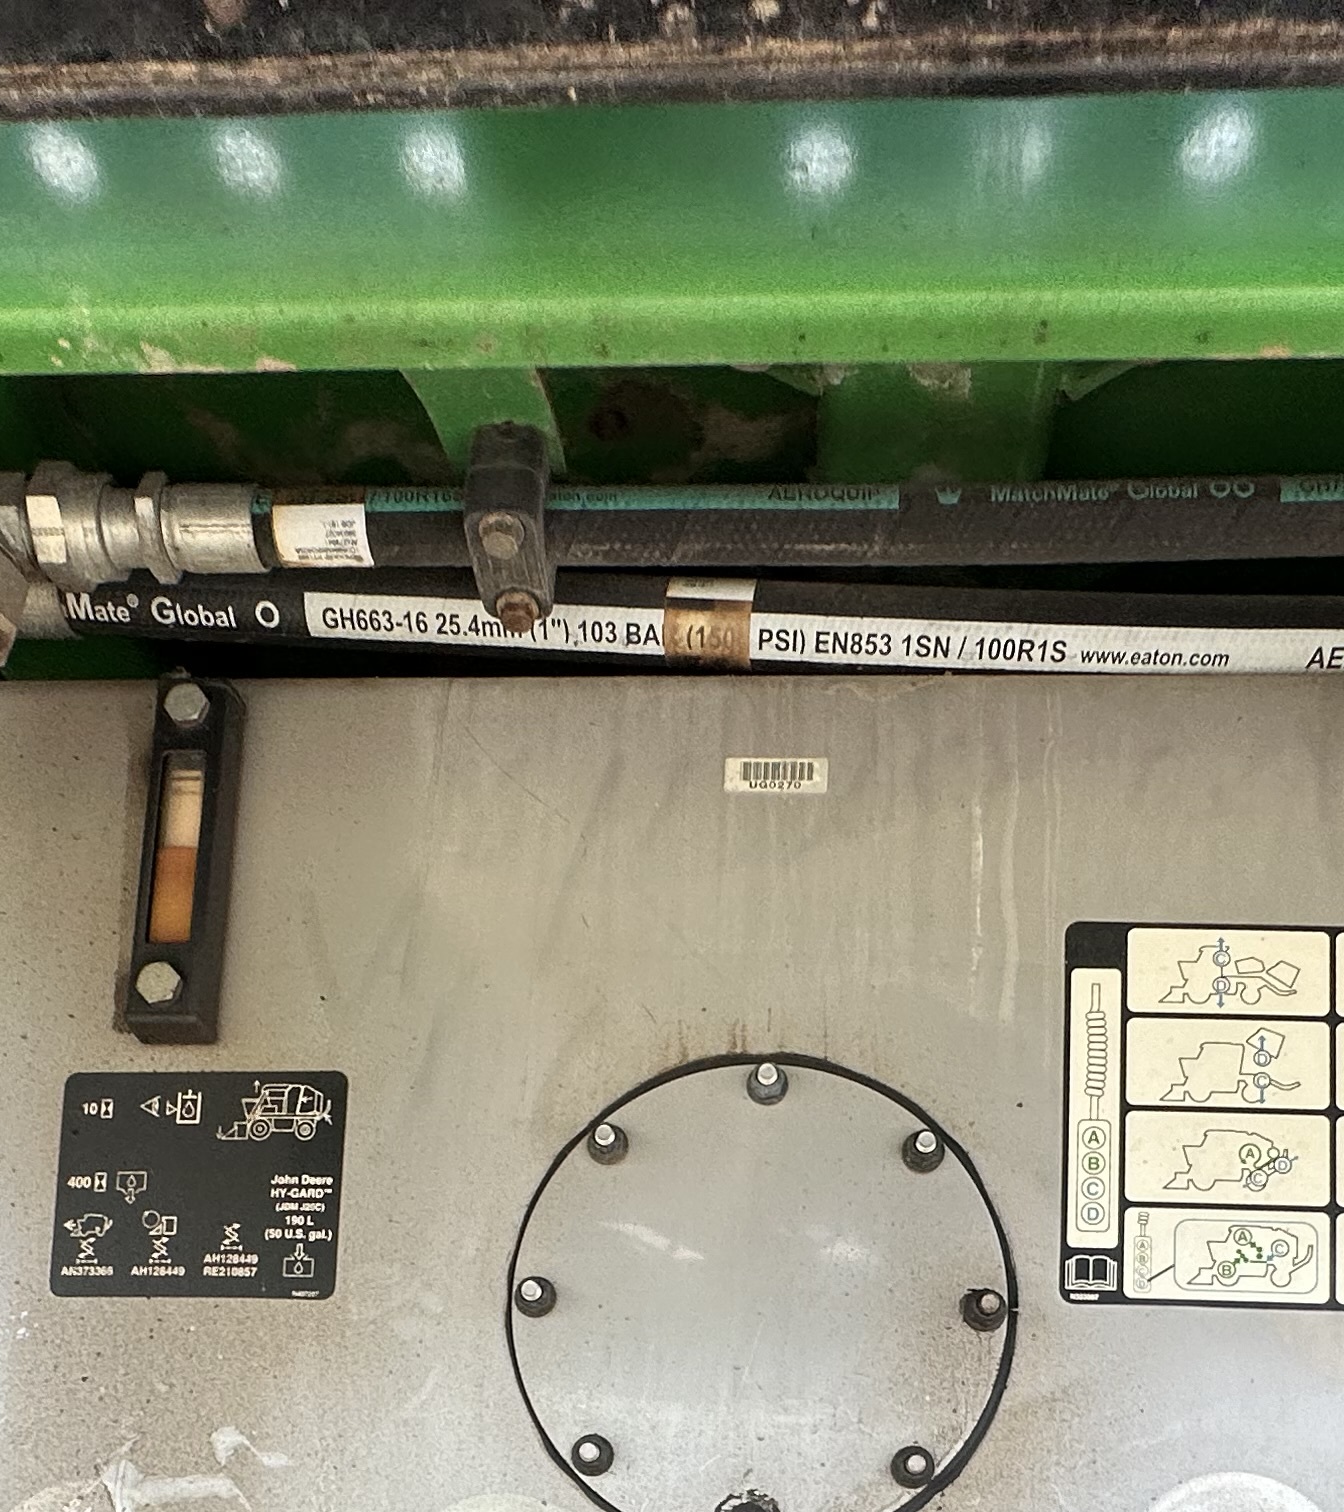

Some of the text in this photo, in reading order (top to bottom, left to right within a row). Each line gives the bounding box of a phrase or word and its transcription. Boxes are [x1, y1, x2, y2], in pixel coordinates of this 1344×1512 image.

[151, 596, 238, 628] Global
[321, 607, 429, 636] GH663-16
[435, 612, 523, 638] 25.4m
[578, 622, 618, 644] 103
[625, 623, 661, 647] BA
[758, 628, 806, 653] PSI)
[814, 630, 892, 657] EN853
[901, 635, 953, 660] 1SN
[974, 637, 1068, 664] 100R1S
[1080, 646, 1230, 670] www.eaton.com
[82, 1102, 98, 1115] 10
[1087, 1130, 1100, 1145] A
[1088, 1156, 1100, 1170] B
[67, 1176, 92, 1189] 400
[270, 1174, 334, 1185] John Deere
[1086, 1182, 1099, 1196] C
[285, 1215, 314, 1226] 190 L
[1087, 1207, 1099, 1221] D
[264, 1228, 283, 1241] (50
[284, 1229, 306, 1239] U.S.
